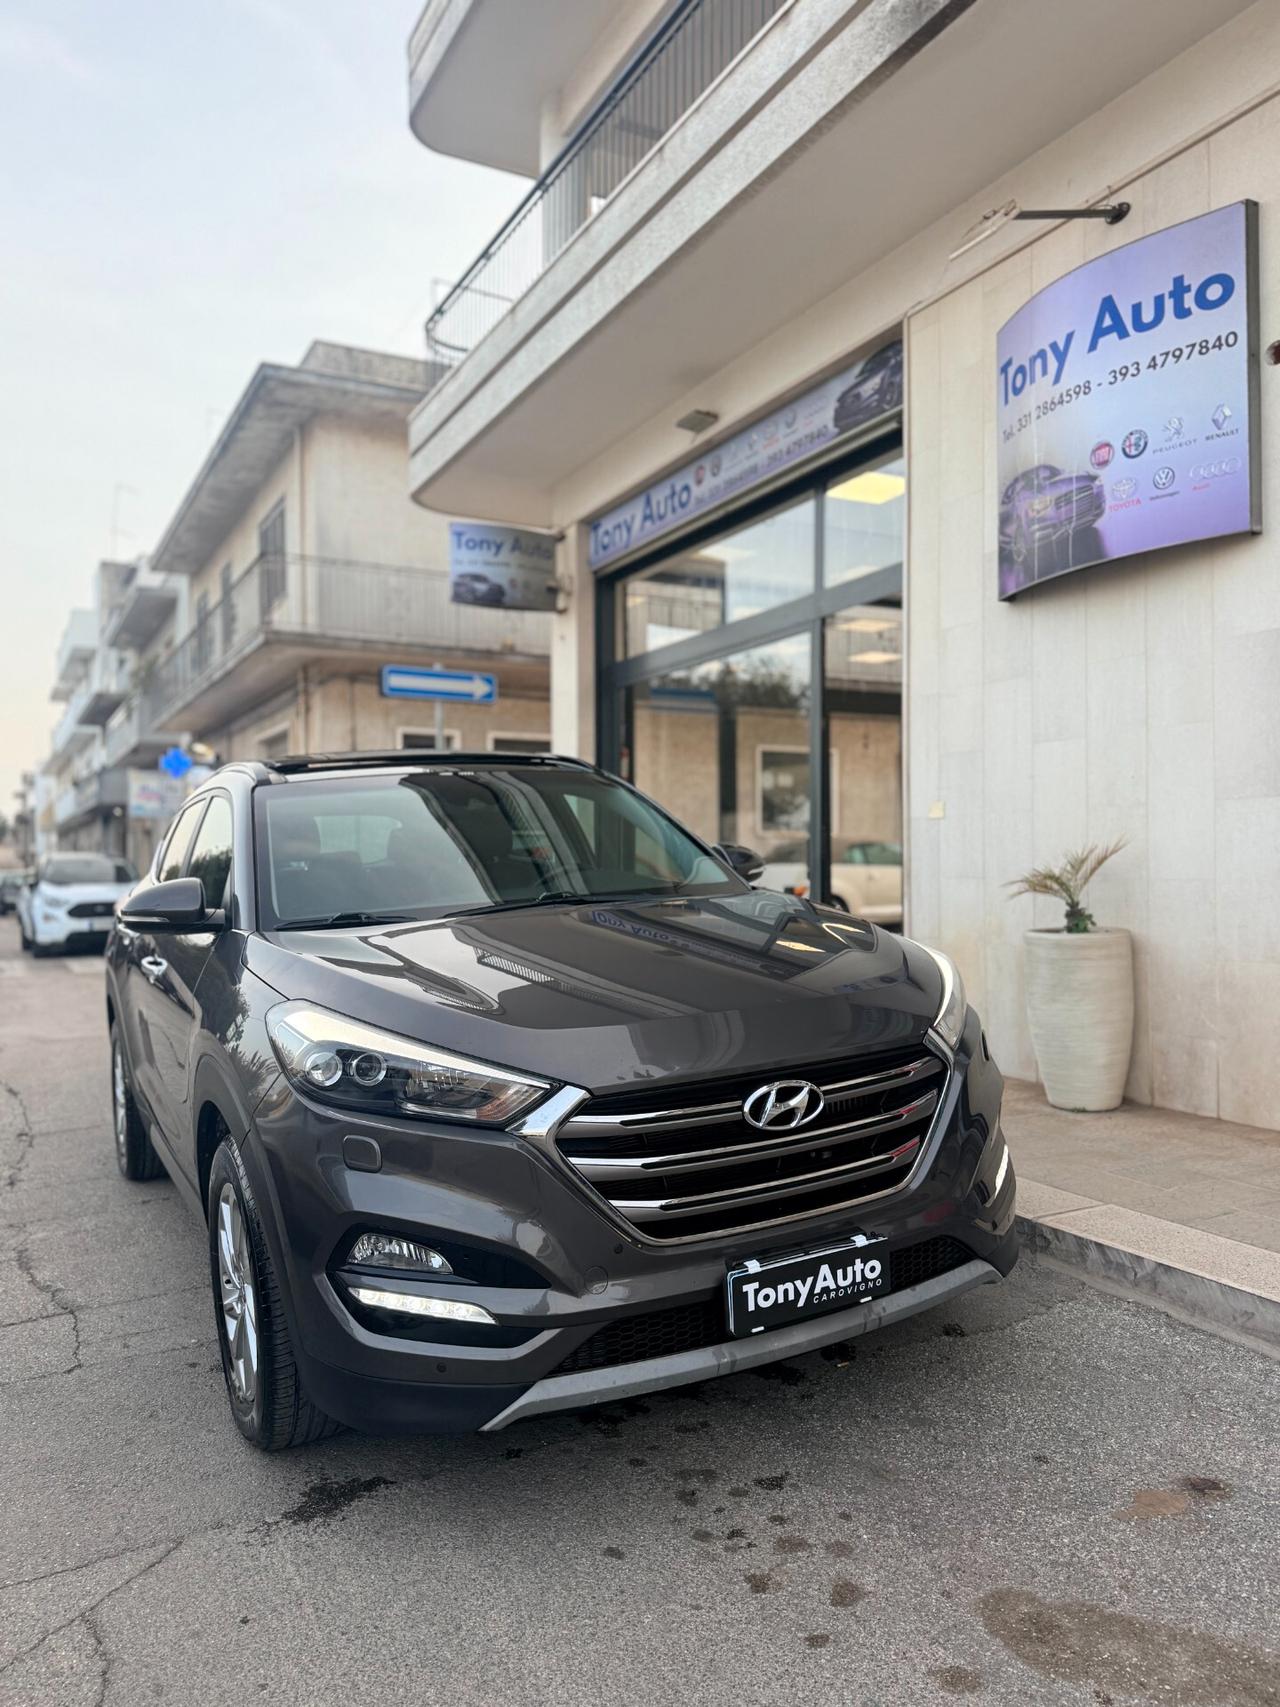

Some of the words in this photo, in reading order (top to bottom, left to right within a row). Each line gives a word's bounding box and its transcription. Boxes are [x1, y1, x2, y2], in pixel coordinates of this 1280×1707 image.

[1000, 330, 1075, 406] Tony
[1087, 273, 1236, 354] Auto
[1017, 411, 1031, 432] 331
[1035, 380, 1092, 420] 2864598
[1108, 361, 1141, 386] 393
[1147, 331, 1239, 371] 4797840
[1152, 438, 1198, 454] PEUGEOT
[1205, 428, 1239, 441] RENAULT
[591, 513, 636, 556] Tony
[641, 483, 691, 531] Auto
[1108, 498, 1142, 513] TOYOTA
[453, 531, 504, 557] Tony
[742, 1258, 882, 1312] TonyAuto
[813, 1278, 883, 1304] CAROVIGNO
